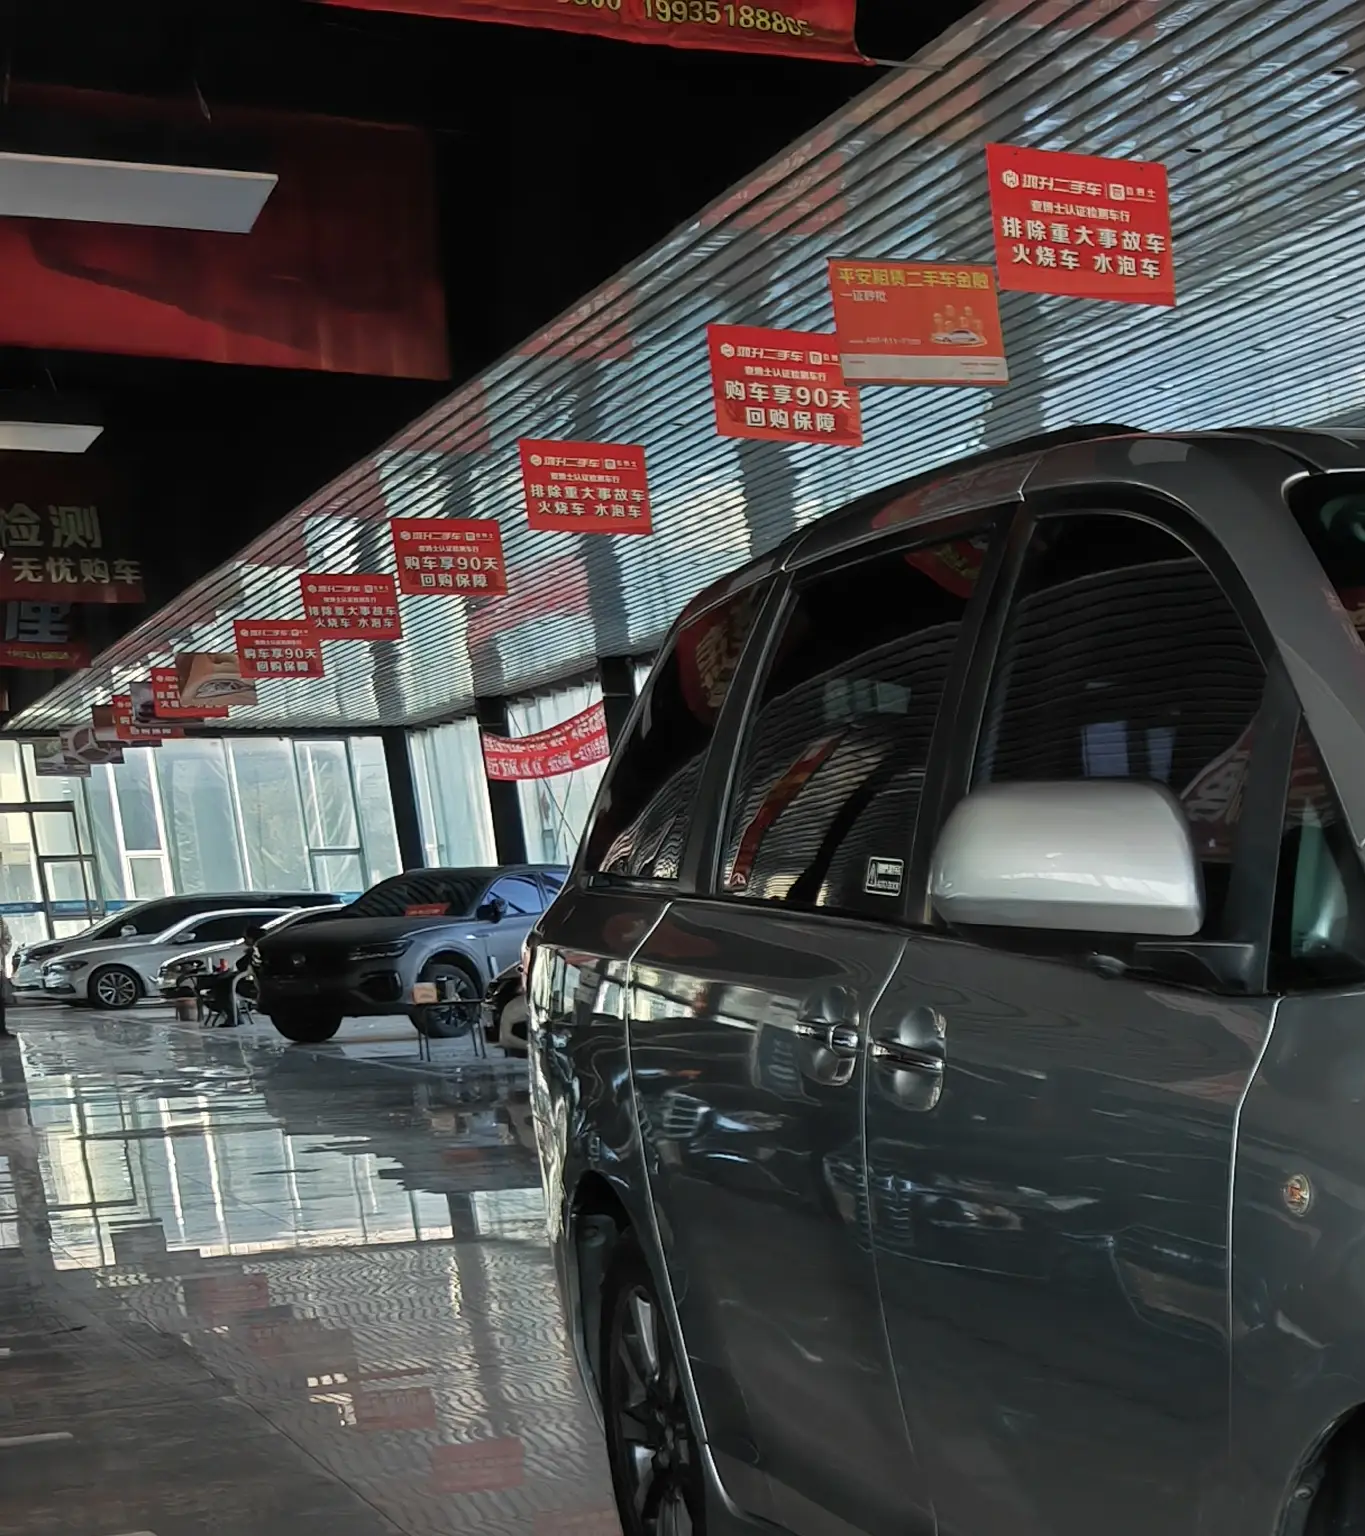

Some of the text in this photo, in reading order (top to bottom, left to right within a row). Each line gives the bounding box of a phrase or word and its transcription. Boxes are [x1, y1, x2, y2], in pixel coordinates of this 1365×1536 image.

[1002, 216, 1166, 254] 排除重大事故车
[1012, 243, 1161, 278] 火烧车 水泡车
[725, 380, 851, 410] 购车享90天
[745, 406, 836, 433] 回购保障
[530, 484, 646, 502] 排除重大事故车
[538, 501, 643, 518] 火烧车 水泡车
[0, 503, 102, 548] 检测
[12, 555, 142, 584] 无忧购车
[404, 556, 499, 570] 购车享90天
[420, 573, 488, 588] 回购保障
